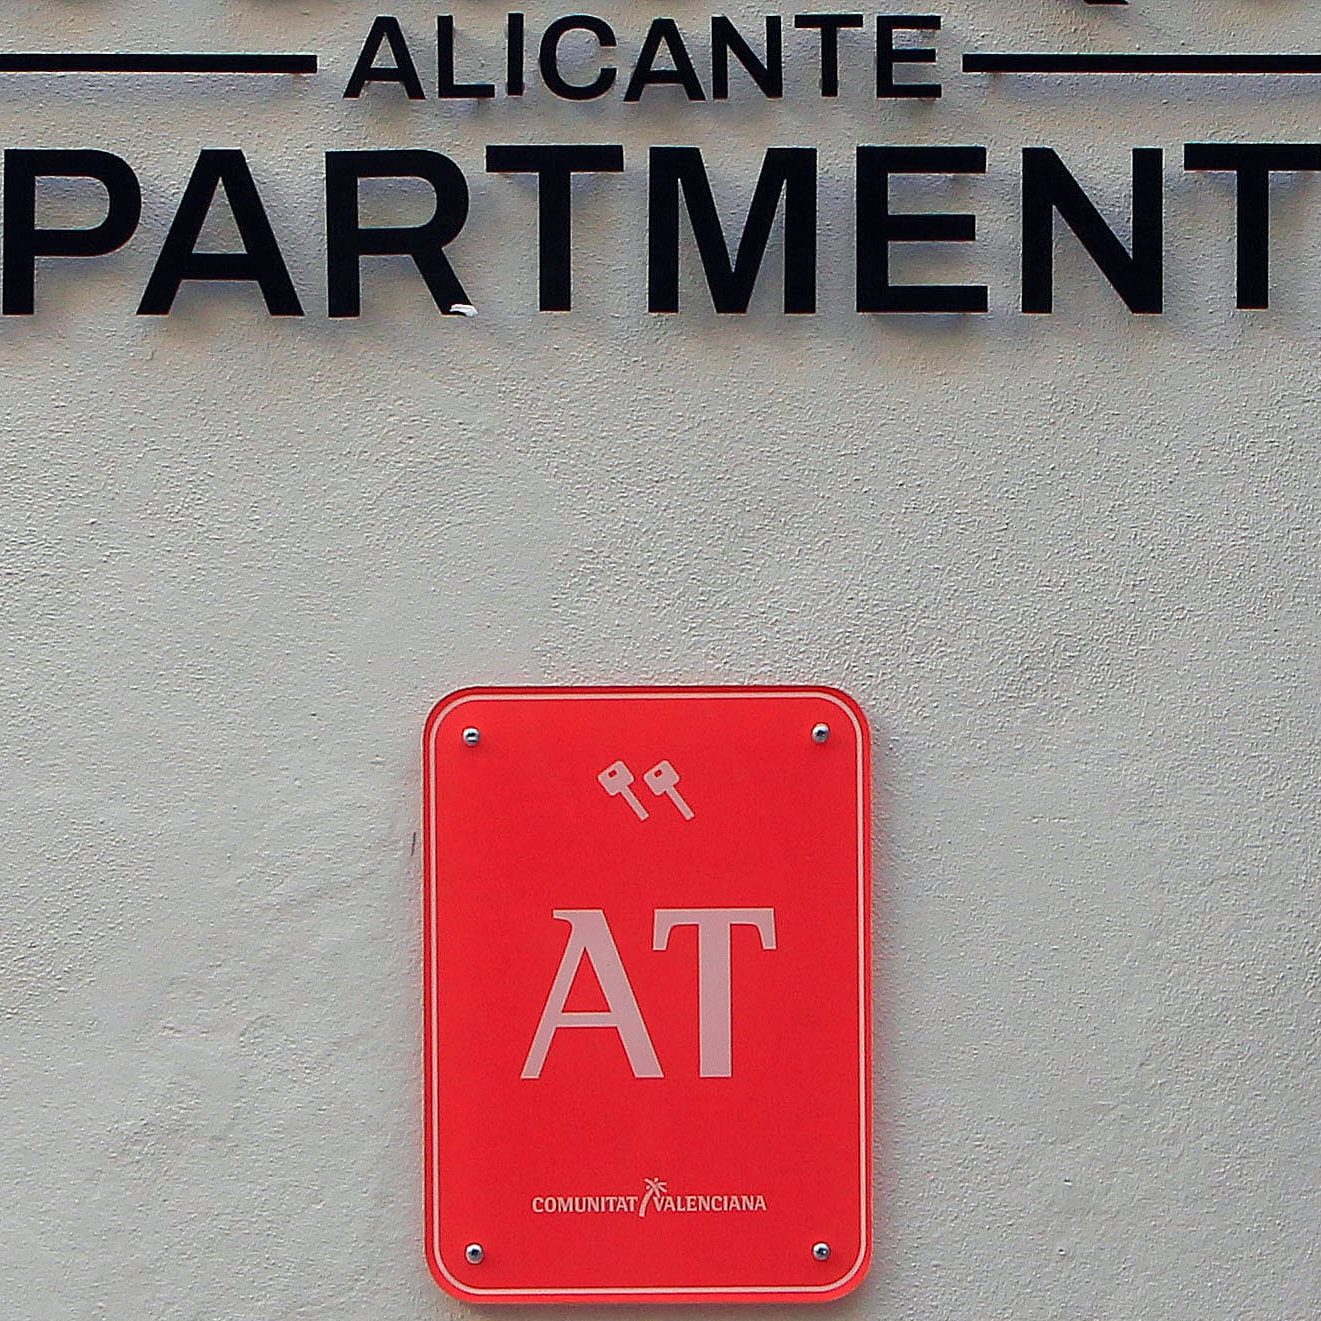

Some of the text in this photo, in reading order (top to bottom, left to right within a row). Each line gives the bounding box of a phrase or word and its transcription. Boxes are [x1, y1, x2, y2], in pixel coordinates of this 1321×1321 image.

[342, 13, 942, 102] ALICANTE
[520, 907, 777, 1079] AT
[531, 1194, 768, 1213] COMUNITAT VALENCIANA
